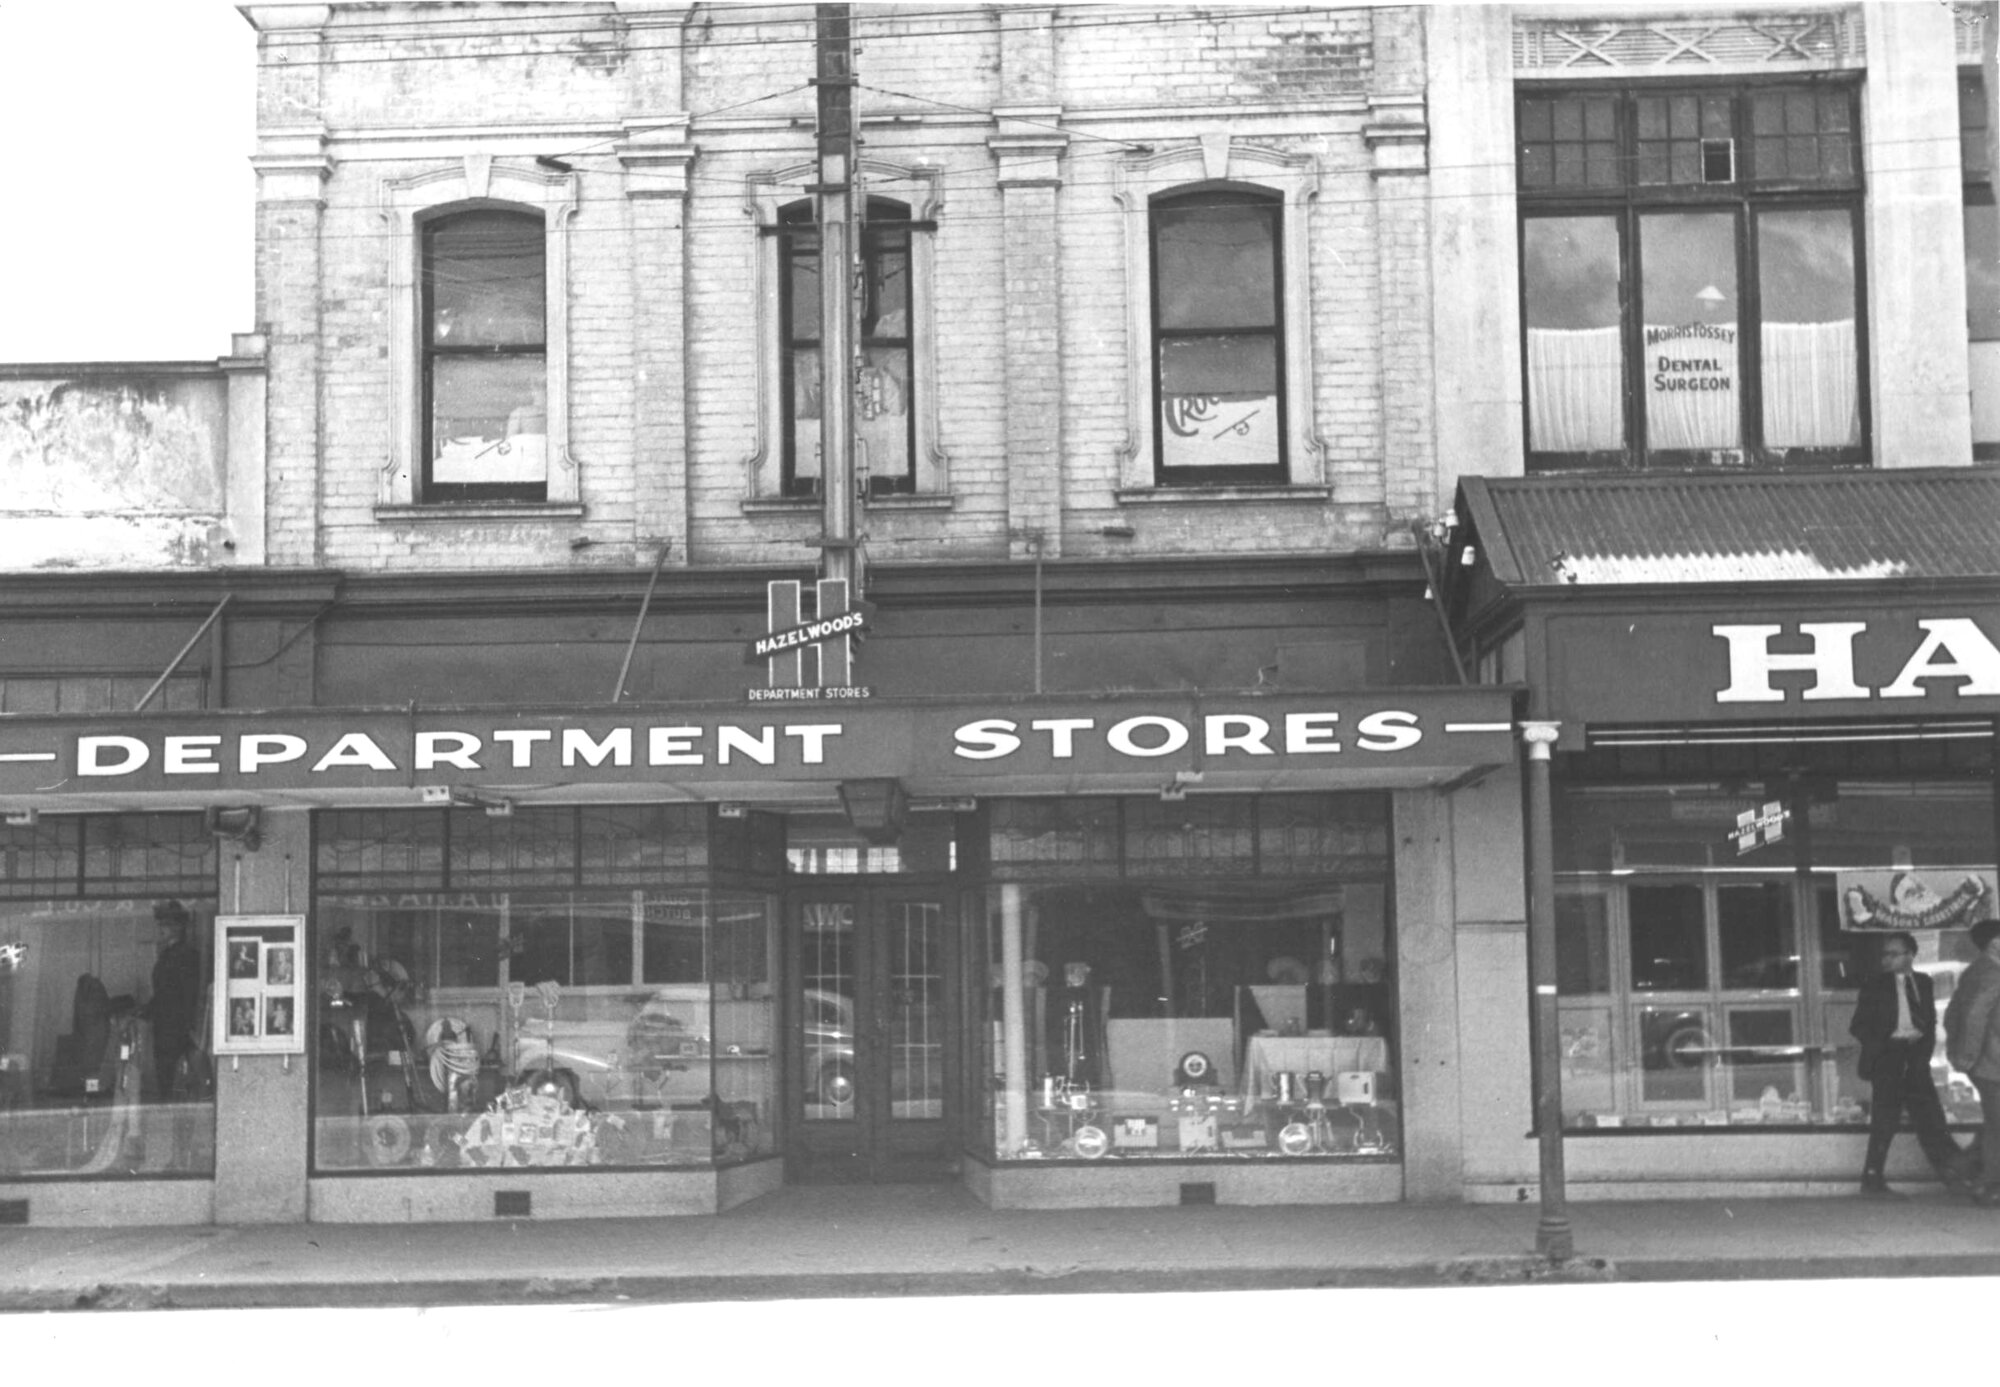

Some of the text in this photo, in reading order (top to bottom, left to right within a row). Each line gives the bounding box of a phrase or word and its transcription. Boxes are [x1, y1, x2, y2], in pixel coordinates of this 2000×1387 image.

[1658, 356, 1722, 372] DENTAL
[1654, 374, 1730, 391] SURGEON
[748, 686, 870, 700] DEPARTMENT STORES
[77, 711, 1422, 776] DEPARTMENT STORES
